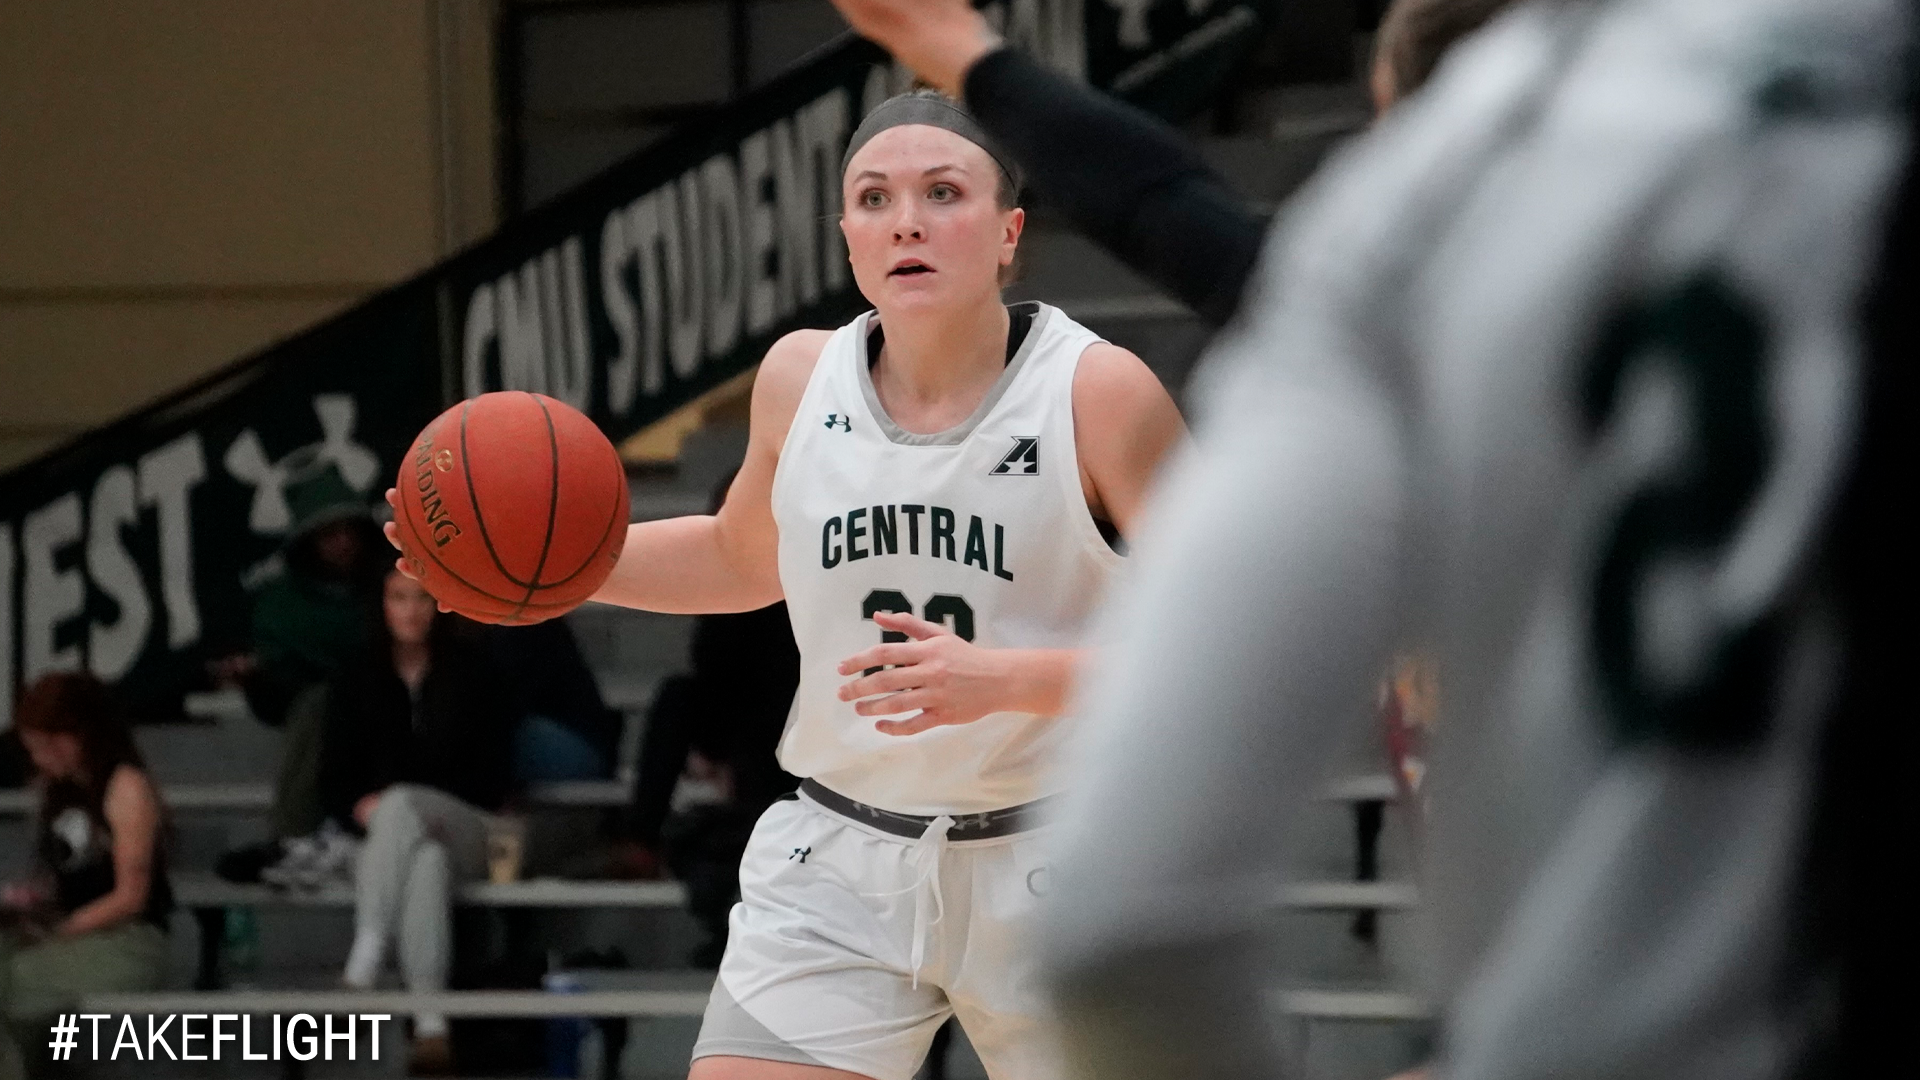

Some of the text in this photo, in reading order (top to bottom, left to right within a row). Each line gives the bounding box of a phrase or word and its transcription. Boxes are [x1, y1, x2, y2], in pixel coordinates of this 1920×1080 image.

[462, 234, 592, 414] CMU
[0, 430, 206, 734] EST
[821, 504, 1014, 582] CENTRAL
